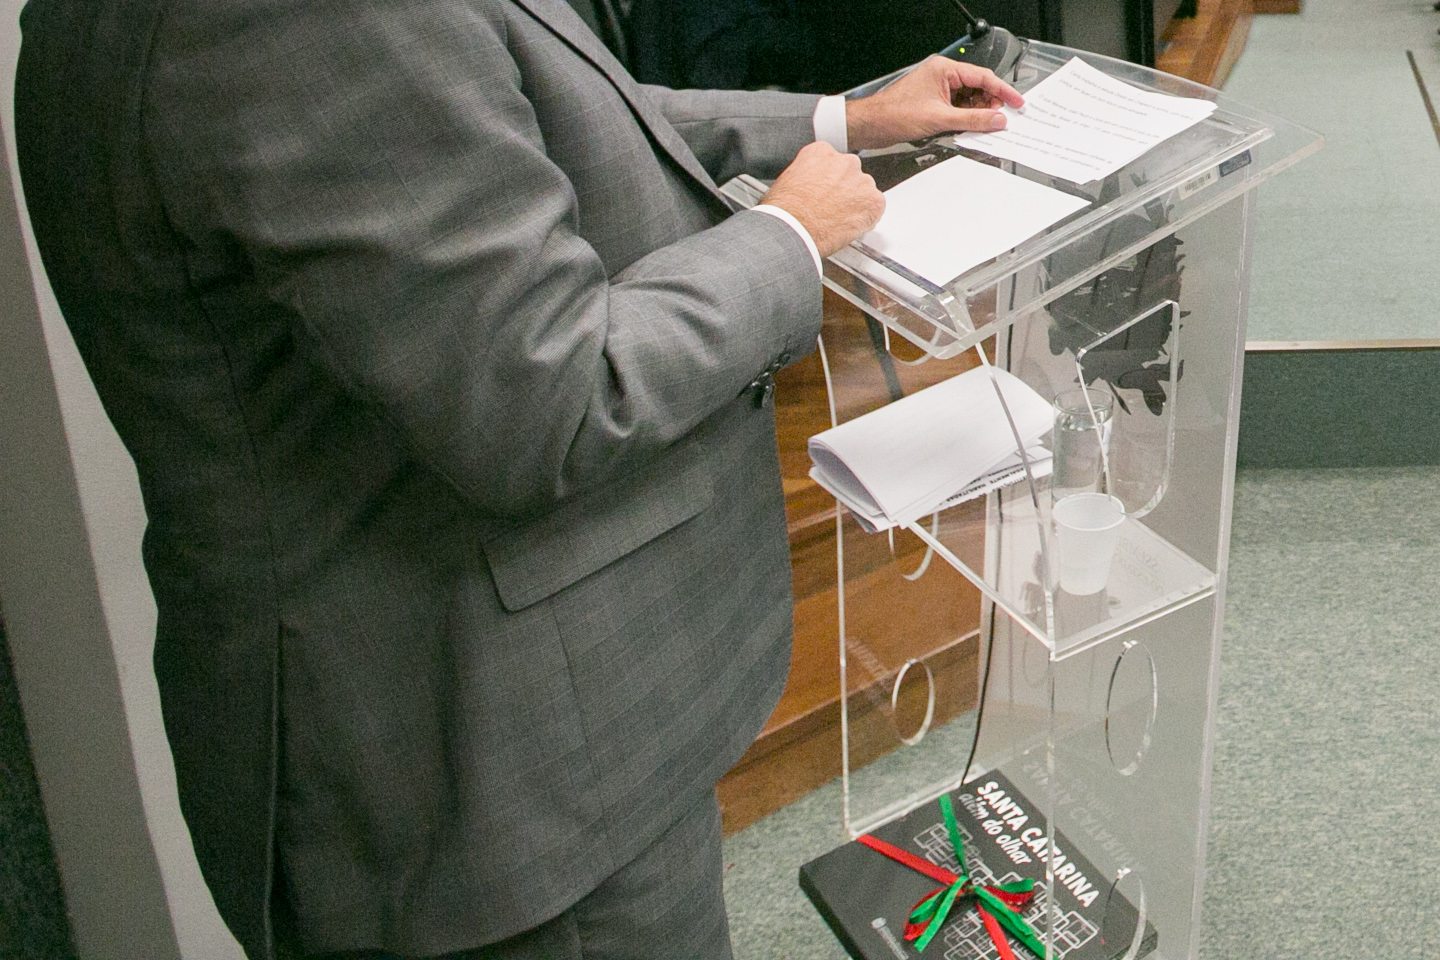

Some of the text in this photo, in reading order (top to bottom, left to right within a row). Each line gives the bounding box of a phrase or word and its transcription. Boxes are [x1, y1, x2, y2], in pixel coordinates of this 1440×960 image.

[977, 781, 1029, 831] SANTA
[1021, 827, 1100, 908] CATARINA
[982, 819, 1004, 835] do
[996, 834, 1032, 865] olhar
